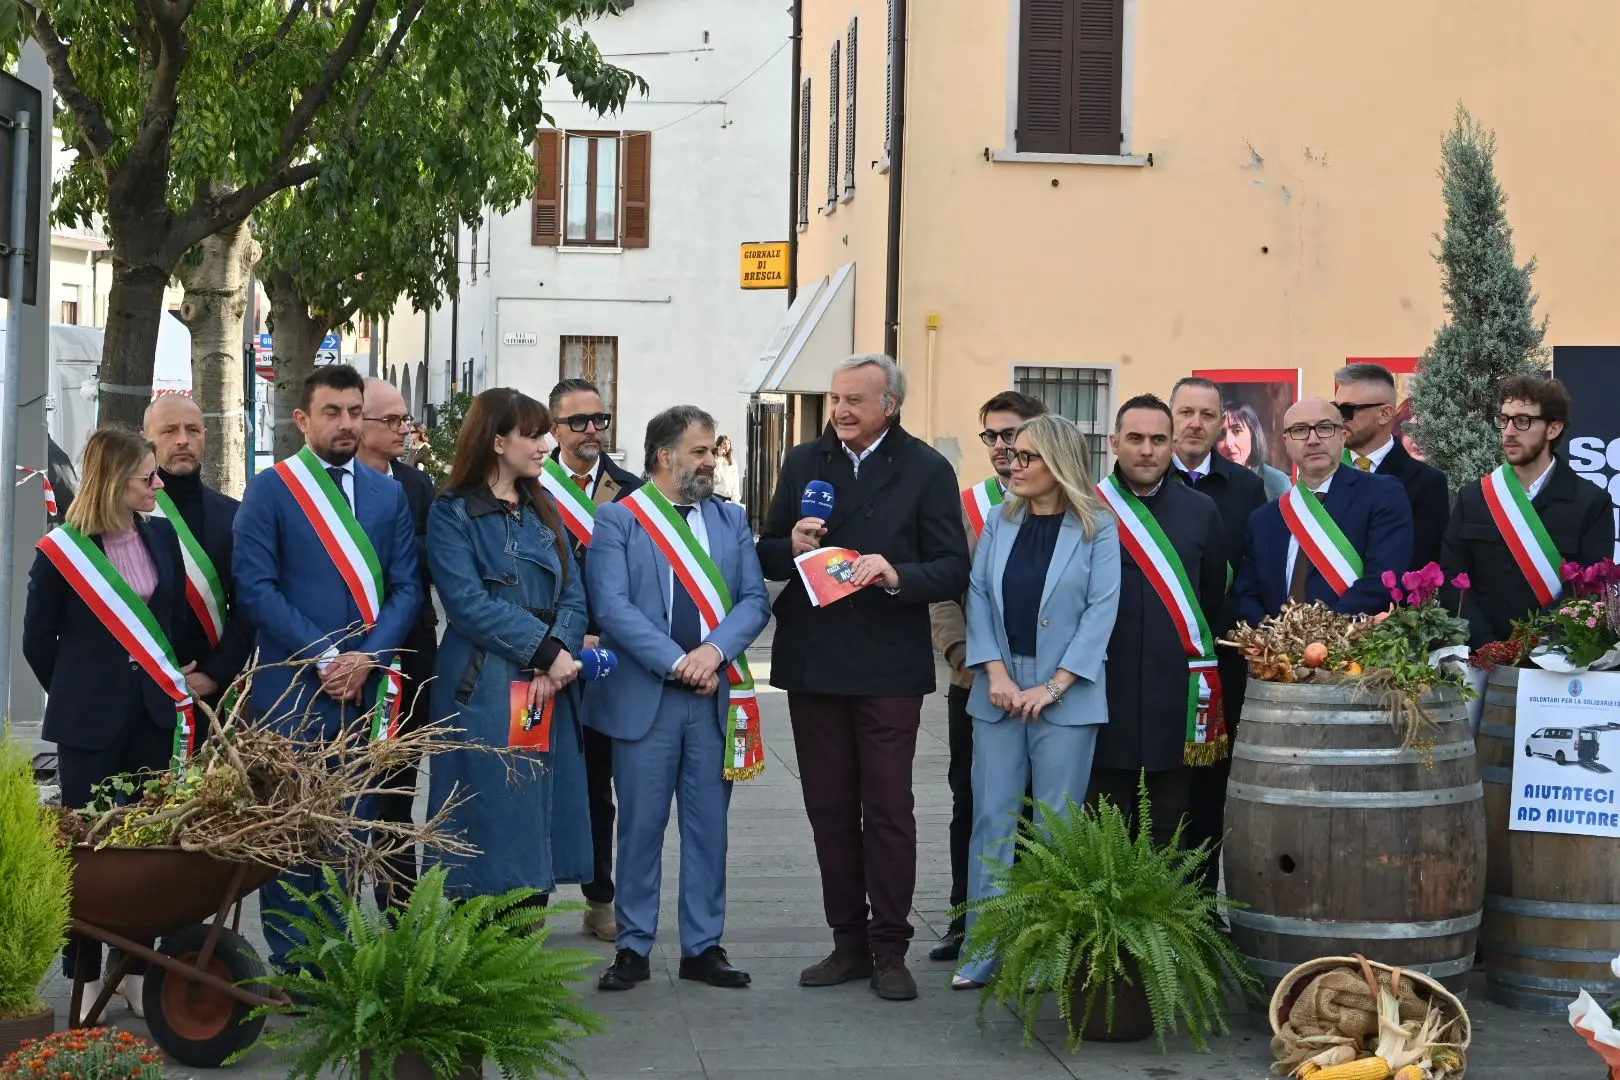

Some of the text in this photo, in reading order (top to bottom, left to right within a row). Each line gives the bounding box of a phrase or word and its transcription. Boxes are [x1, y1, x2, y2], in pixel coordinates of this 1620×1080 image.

[744, 250, 781, 259] GIORNALE
[757, 260, 767, 269] DI
[743, 271, 782, 281] BRESCIA
[1529, 696, 1560, 704] VOLONTARI
[1561, 697, 1573, 705] PER
[1524, 783, 1614, 804] AIUTATECI
[1517, 806, 1619, 828] AD AIUTARE
